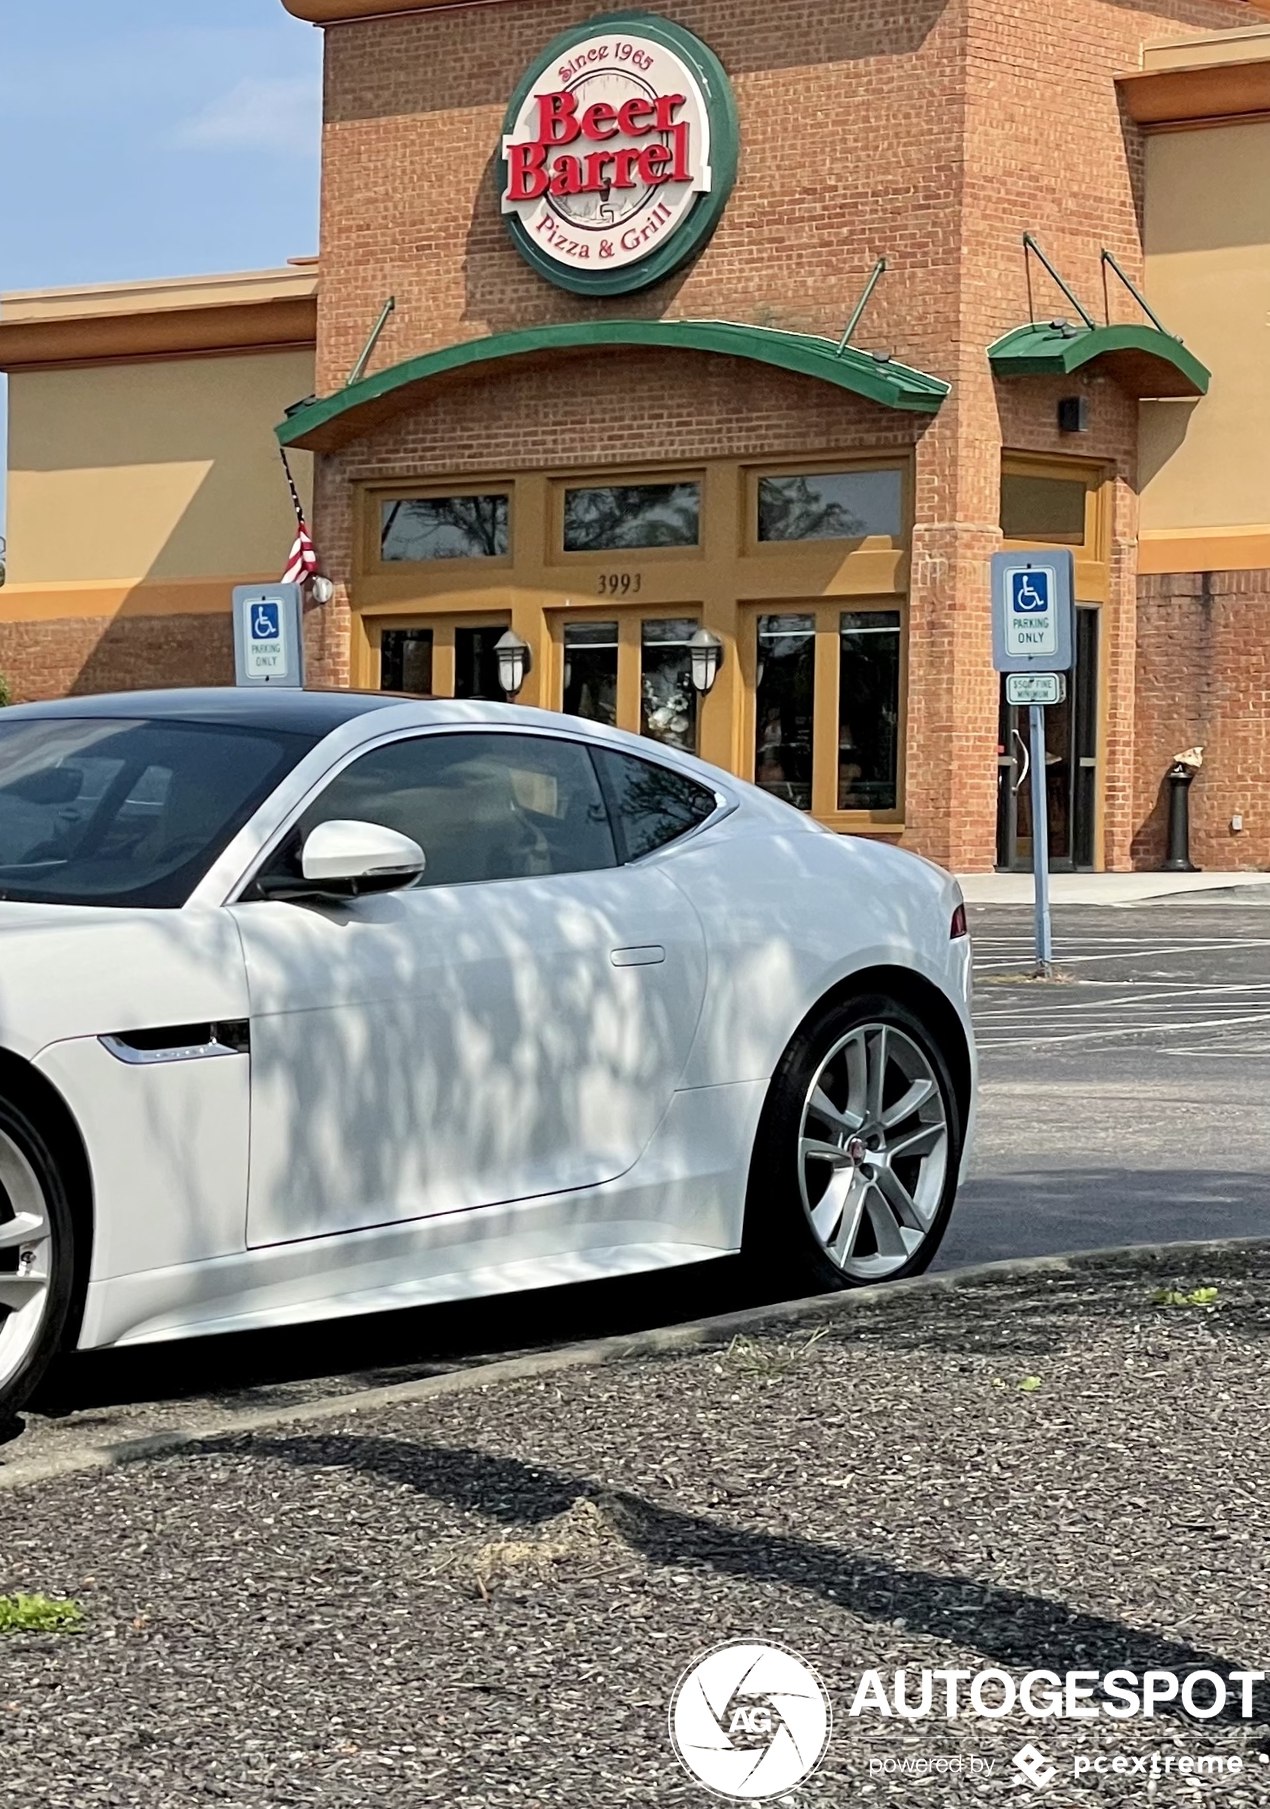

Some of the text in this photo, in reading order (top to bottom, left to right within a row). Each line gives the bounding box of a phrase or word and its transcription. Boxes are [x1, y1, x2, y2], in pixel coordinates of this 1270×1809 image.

[557, 42, 655, 83] Since 1965
[534, 91, 687, 147] Beer
[505, 121, 693, 201] Barrel
[535, 201, 672, 259] Pizza & Grill
[598, 573, 641, 594] 3993
[1013, 617, 1049, 629] PARKING
[1018, 632, 1044, 643] ONLY
[251, 643, 280, 654] PARKING
[256, 656, 277, 667] ONLY
[1036, 679, 1052, 688] FINE
